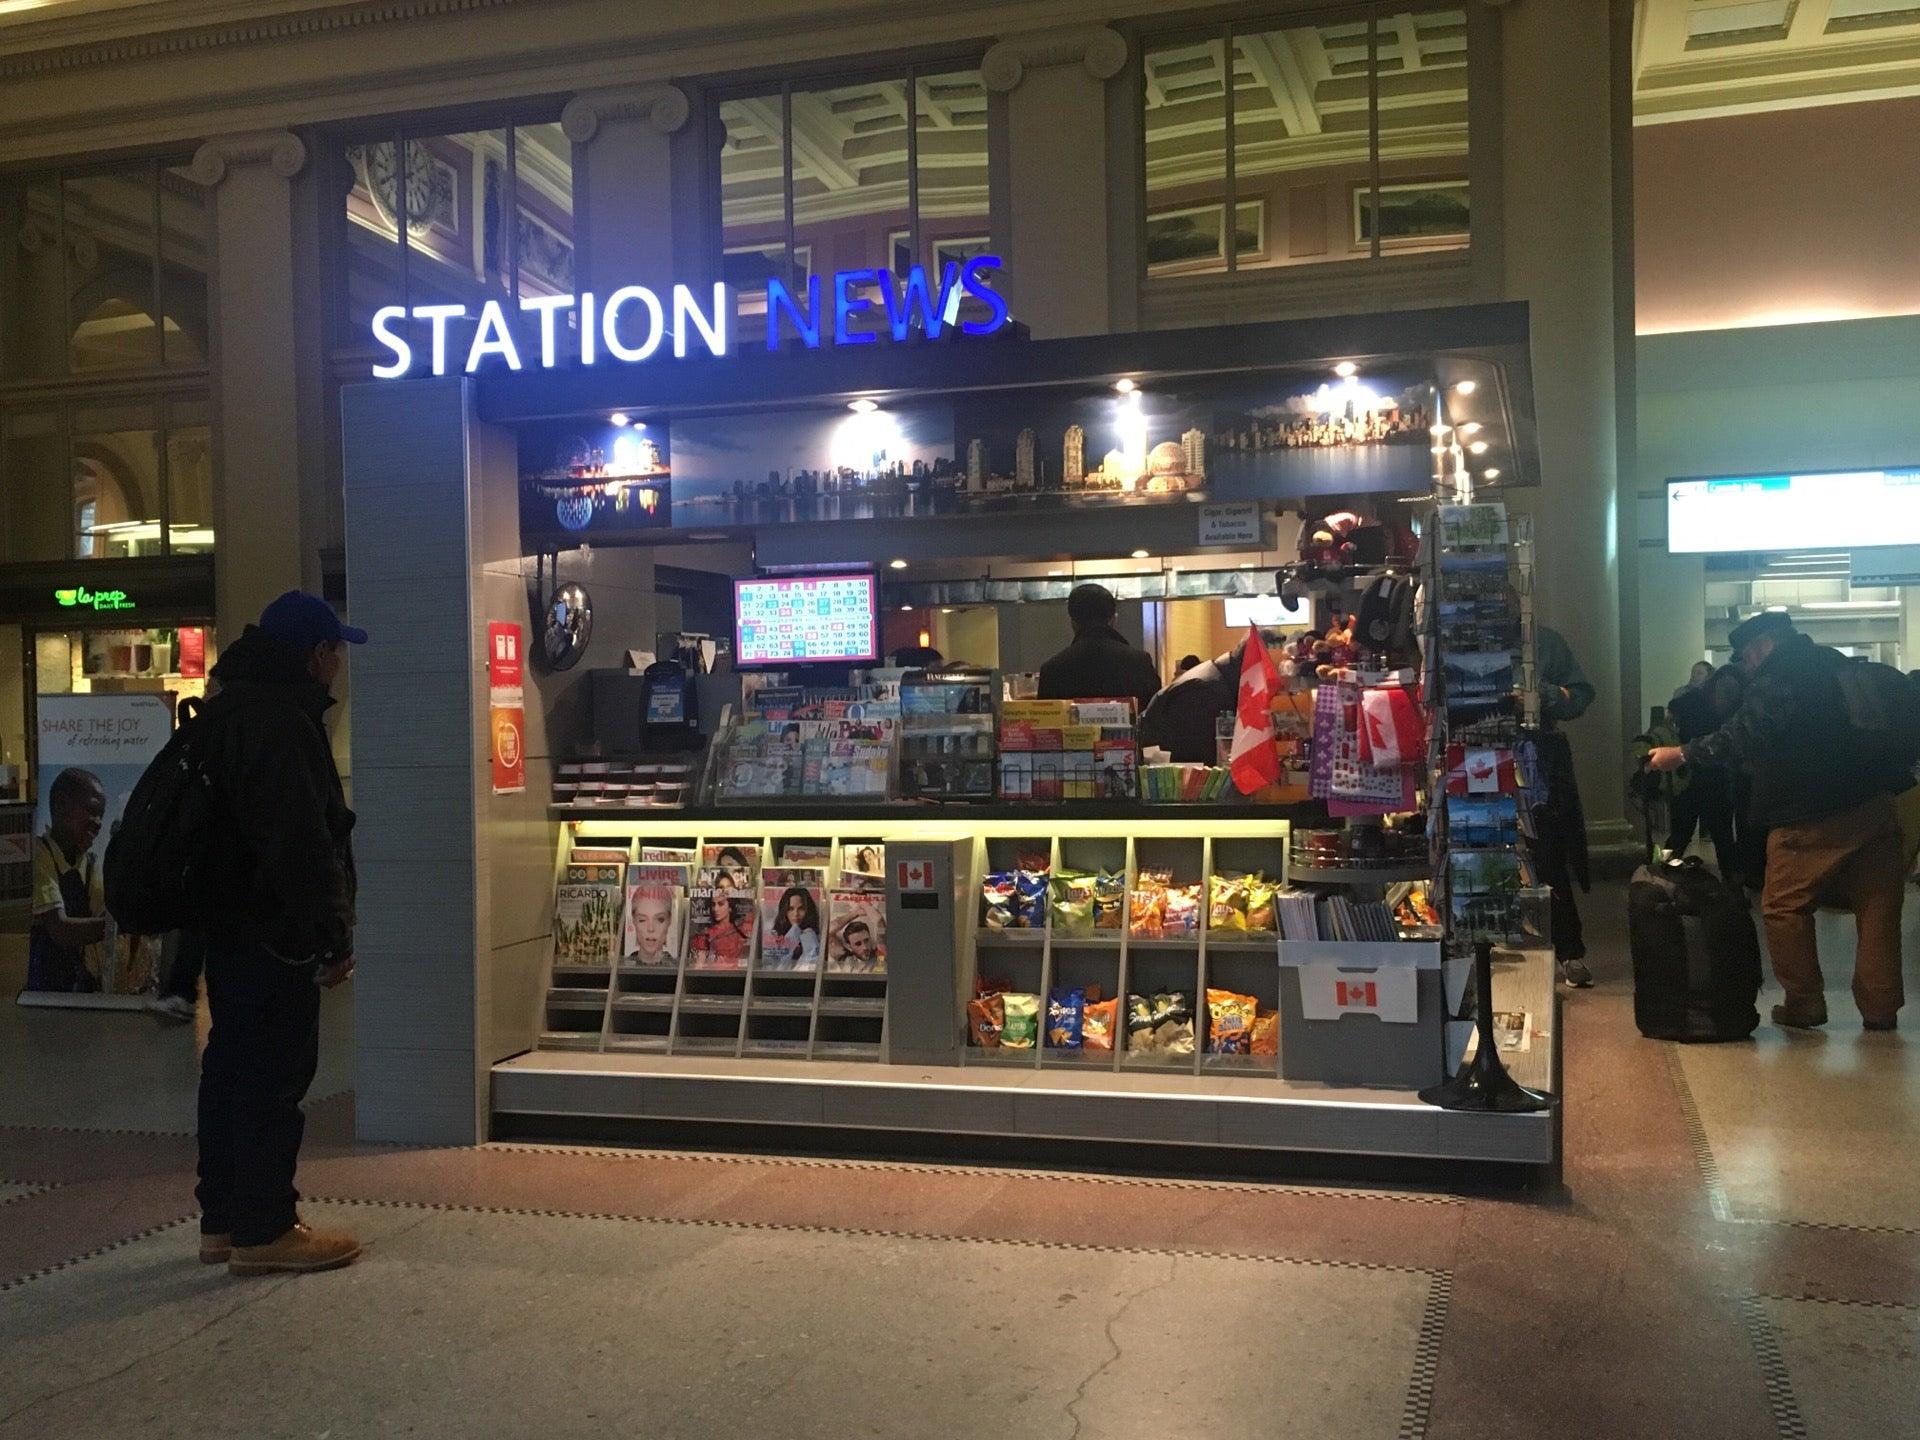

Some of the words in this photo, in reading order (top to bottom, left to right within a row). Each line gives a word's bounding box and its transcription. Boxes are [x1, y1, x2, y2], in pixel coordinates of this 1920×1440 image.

[371, 281, 728, 379] STATION
[766, 254, 1010, 352] NEWS
[77, 586, 94, 604] la
[93, 589, 127, 610] prep
[42, 718, 83, 733] SHARE
[88, 718, 114, 732] THE
[117, 717, 140, 735] JOY
[79, 733, 121, 750] refreshing
[123, 736, 149, 745] water
[559, 888, 608, 899] RICARDO
